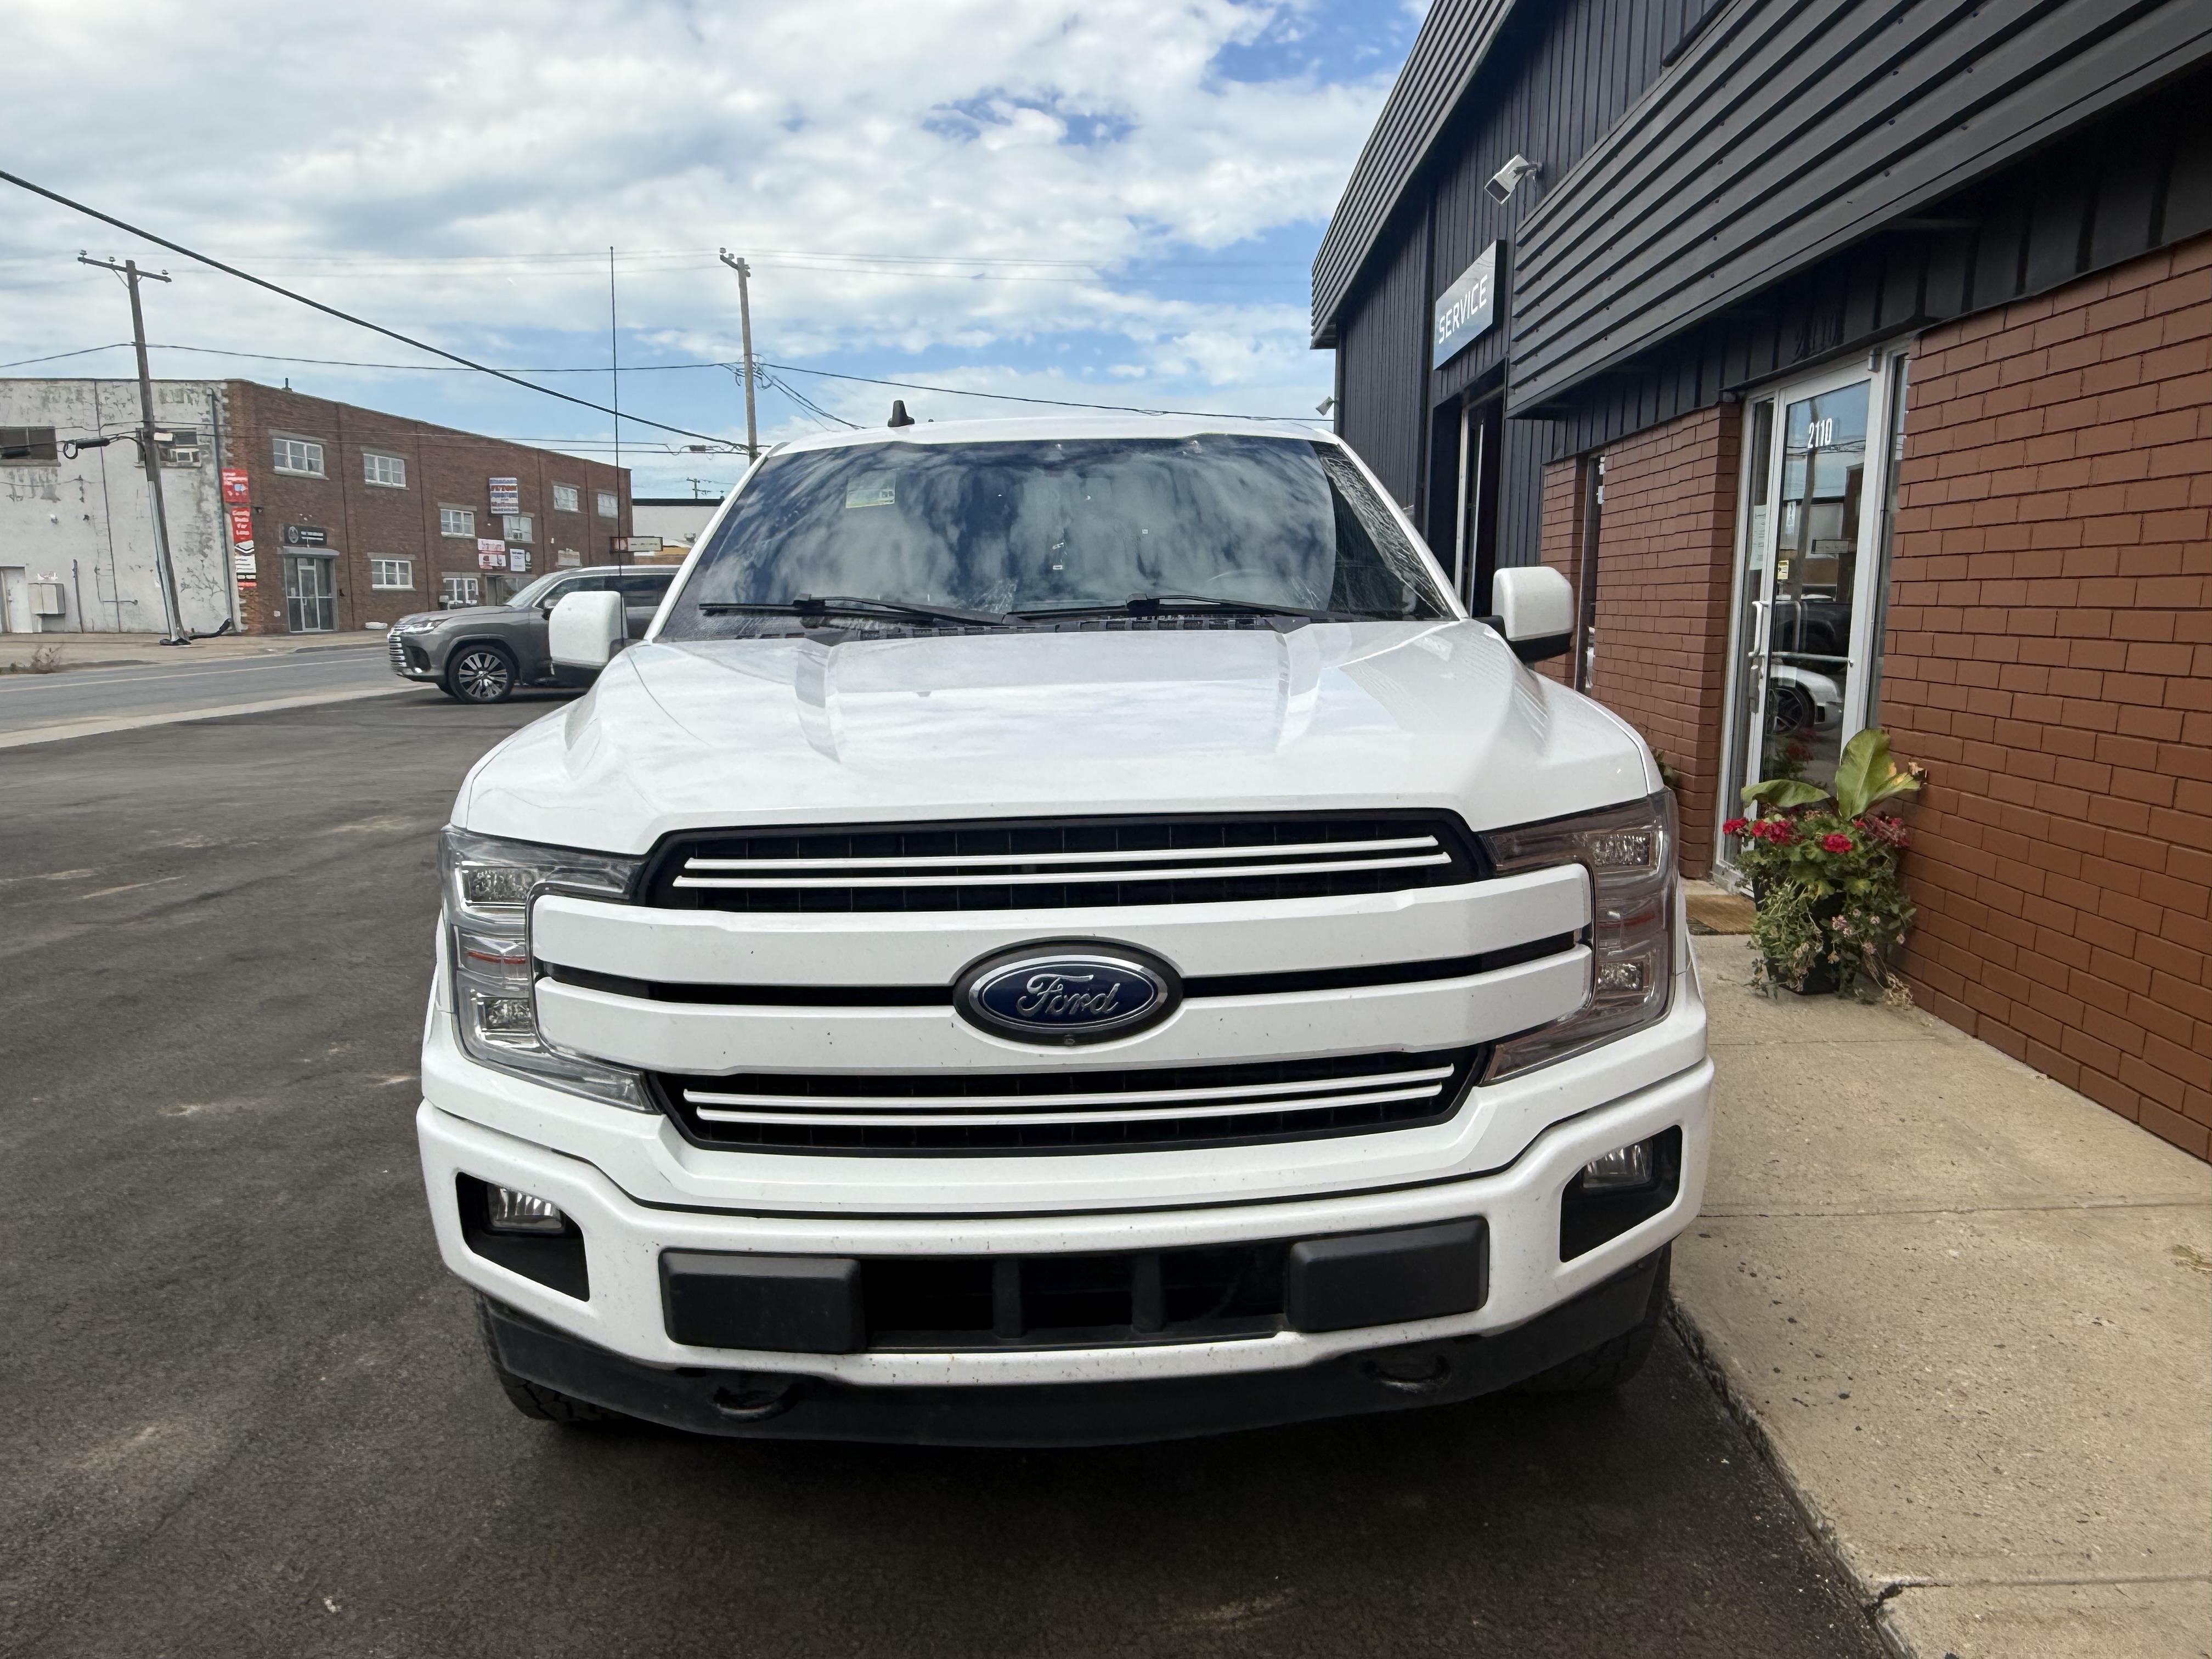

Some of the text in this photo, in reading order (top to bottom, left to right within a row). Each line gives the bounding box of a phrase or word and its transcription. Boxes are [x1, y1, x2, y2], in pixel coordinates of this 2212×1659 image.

[1438, 274, 1488, 345] SERVICE
[1807, 418, 1832, 449] 2110
[1015, 973, 1121, 1018] Ford
